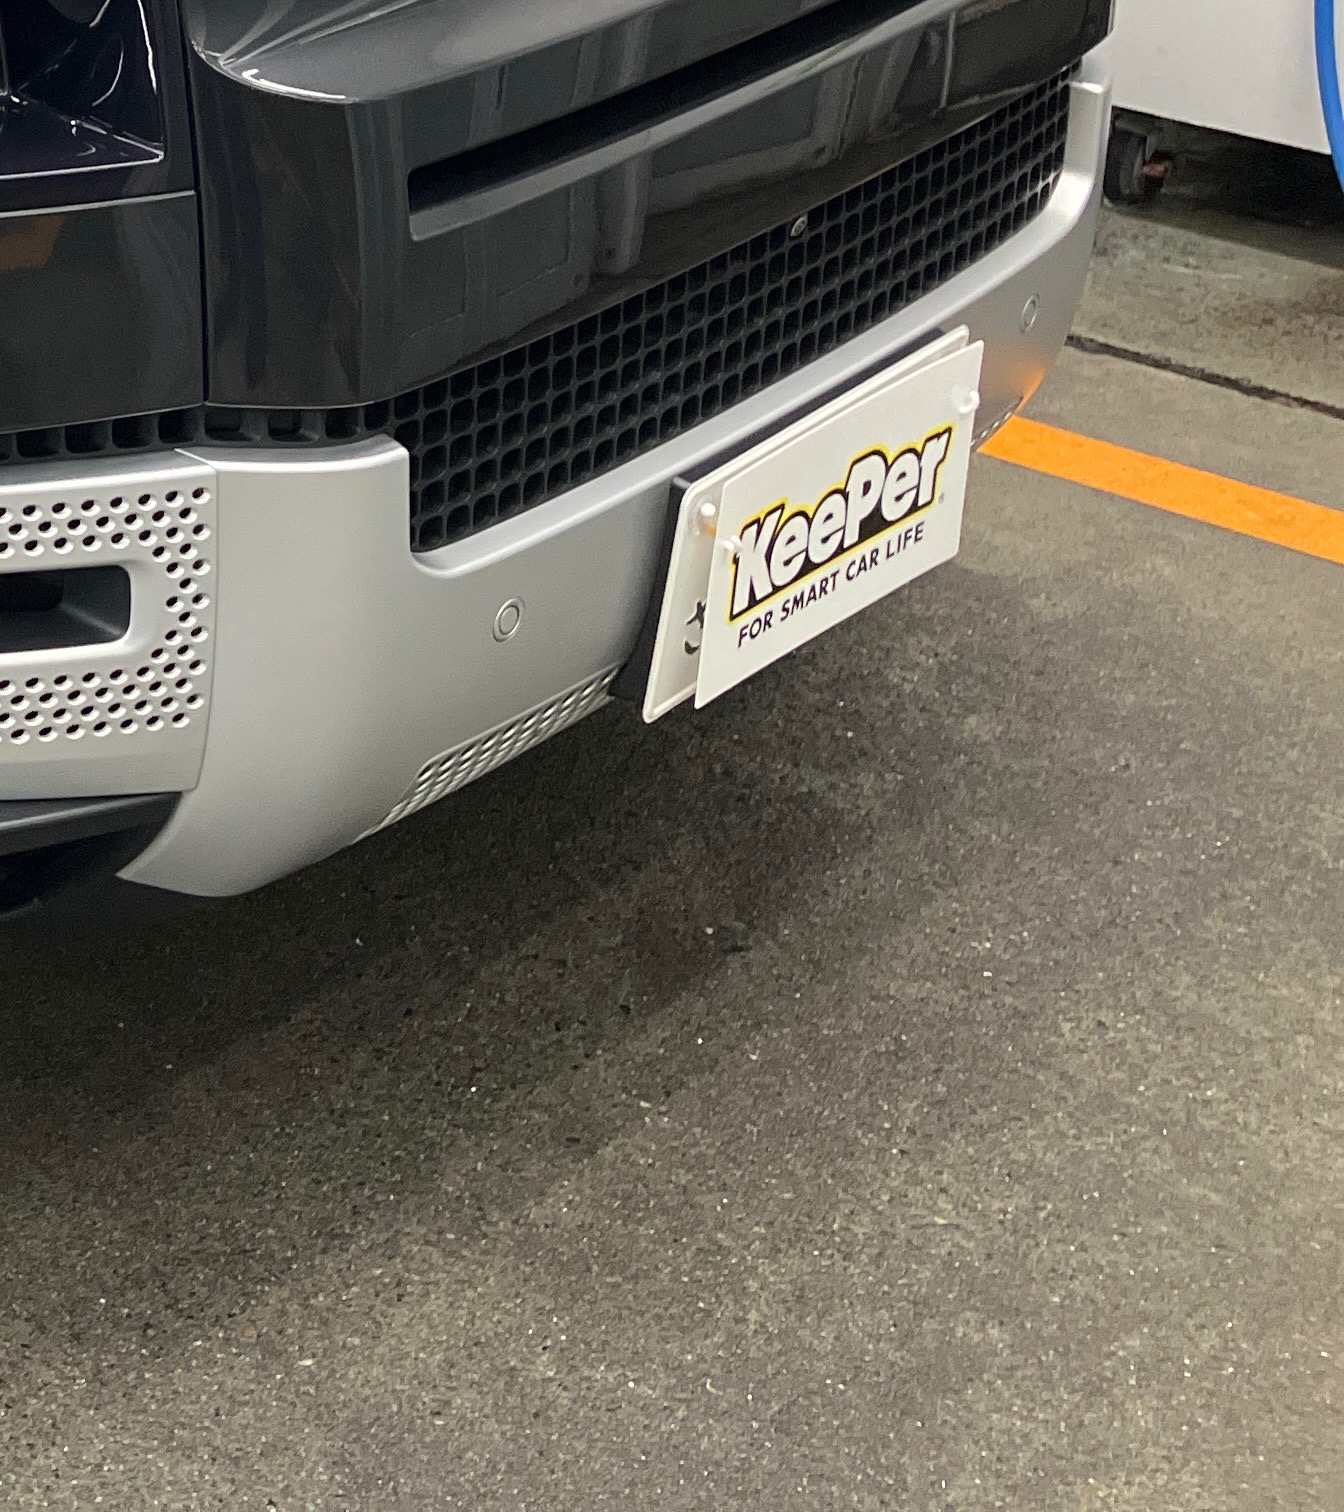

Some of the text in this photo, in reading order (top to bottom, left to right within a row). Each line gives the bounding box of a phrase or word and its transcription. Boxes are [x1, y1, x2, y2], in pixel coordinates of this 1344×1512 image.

[728, 424, 954, 624] KeePer
[738, 610, 774, 648] FOR
[779, 569, 841, 622] SMART
[844, 546, 880, 582] CAR
[885, 520, 926, 560] LIFE
